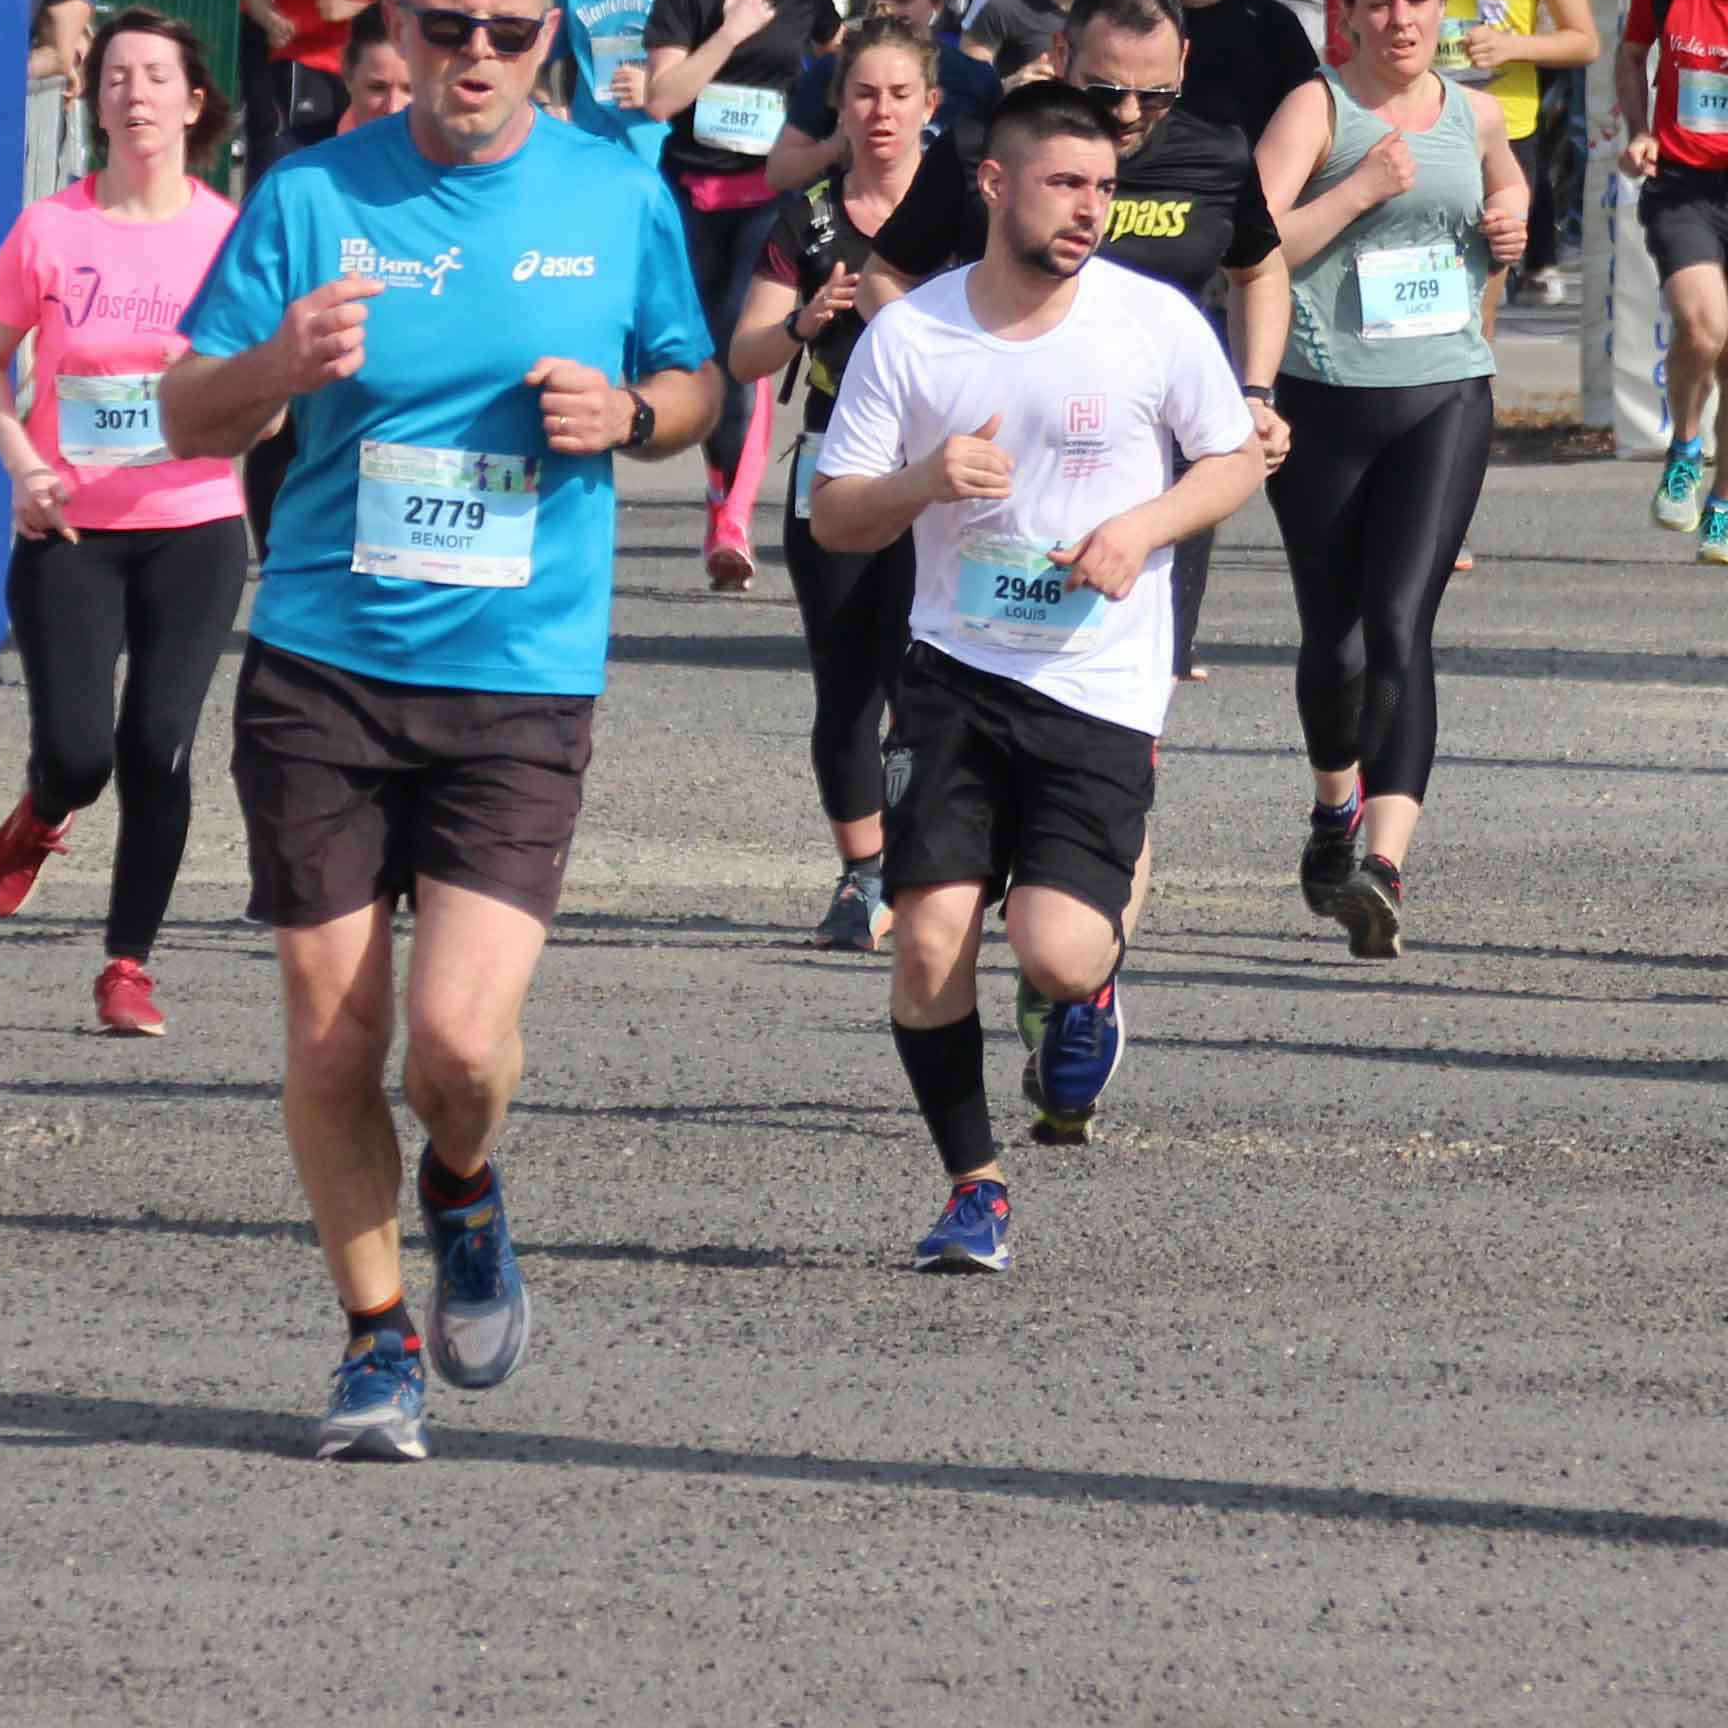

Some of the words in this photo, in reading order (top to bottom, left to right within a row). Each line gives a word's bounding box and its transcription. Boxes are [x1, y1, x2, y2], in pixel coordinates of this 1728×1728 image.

[539, 254, 596, 279] asics
[1394, 278, 1440, 302] 2769
[94, 408, 150, 430] 3071
[403, 495, 487, 531] 2779
[410, 531, 476, 549] BENOIT
[994, 575, 1062, 605] 2946
[1004, 606, 1048, 621] LOUIS
